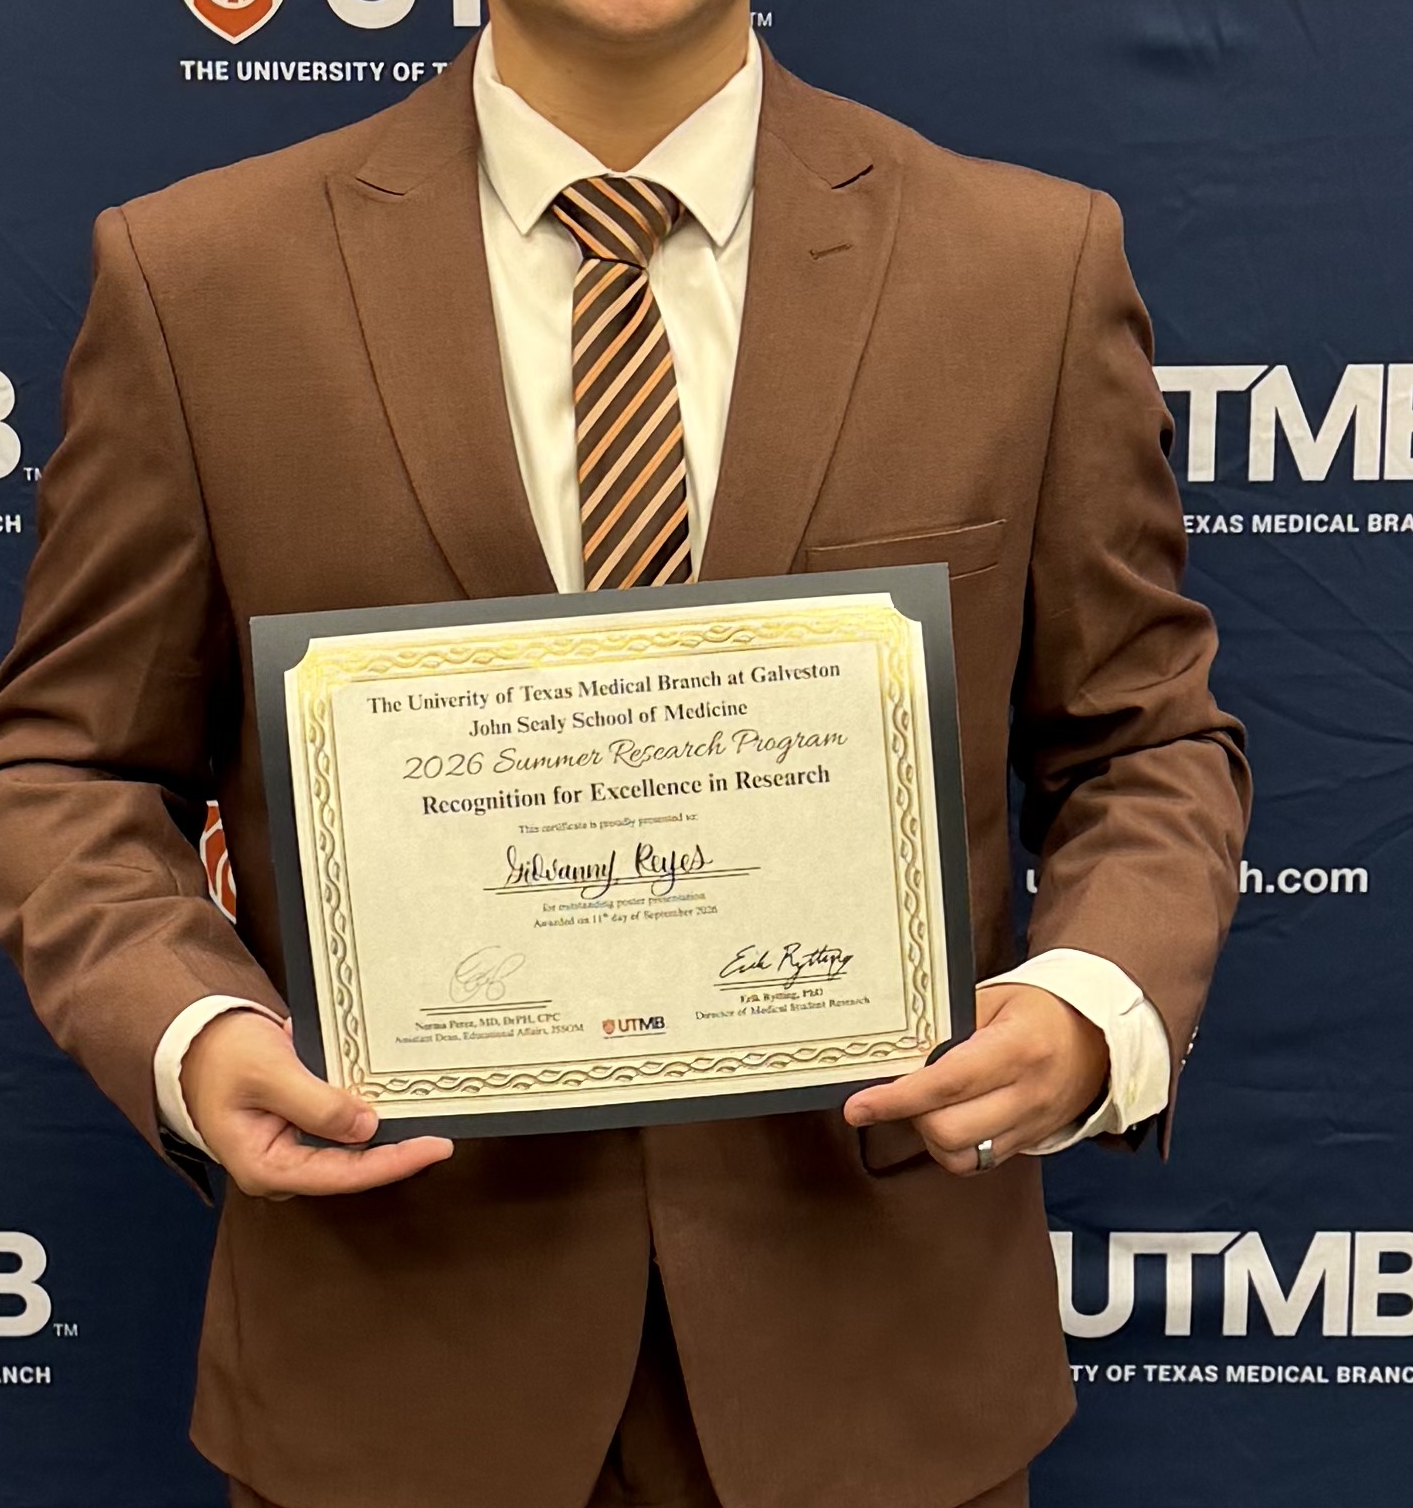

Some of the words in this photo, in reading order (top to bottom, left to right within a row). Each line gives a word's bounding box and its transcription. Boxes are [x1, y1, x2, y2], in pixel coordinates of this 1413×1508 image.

[367, 697, 402, 714] The
[408, 690, 489, 710] Univerity
[496, 687, 514, 704] of
[519, 684, 573, 701] Texas
[578, 676, 652, 697] Medical
[658, 671, 721, 691] Branch
[727, 670, 744, 685] at
[751, 664, 840, 684] Galveston
[469, 719, 512, 737] John
[517, 714, 567, 734] Sealy
[572, 709, 633, 729] School
[639, 706, 657, 722] of
[664, 700, 748, 722] Medicine
[403, 752, 485, 780] 2026
[493, 747, 603, 773] Summer
[608, 730, 726, 768] Research
[732, 728, 849, 764] Program
[422, 789, 546, 816] Recognition
[553, 786, 583, 805] for
[590, 777, 702, 802] Excellence
[709, 773, 728, 792] in
[736, 764, 830, 790] Research
[617, 1016, 665, 1033] UTMB
